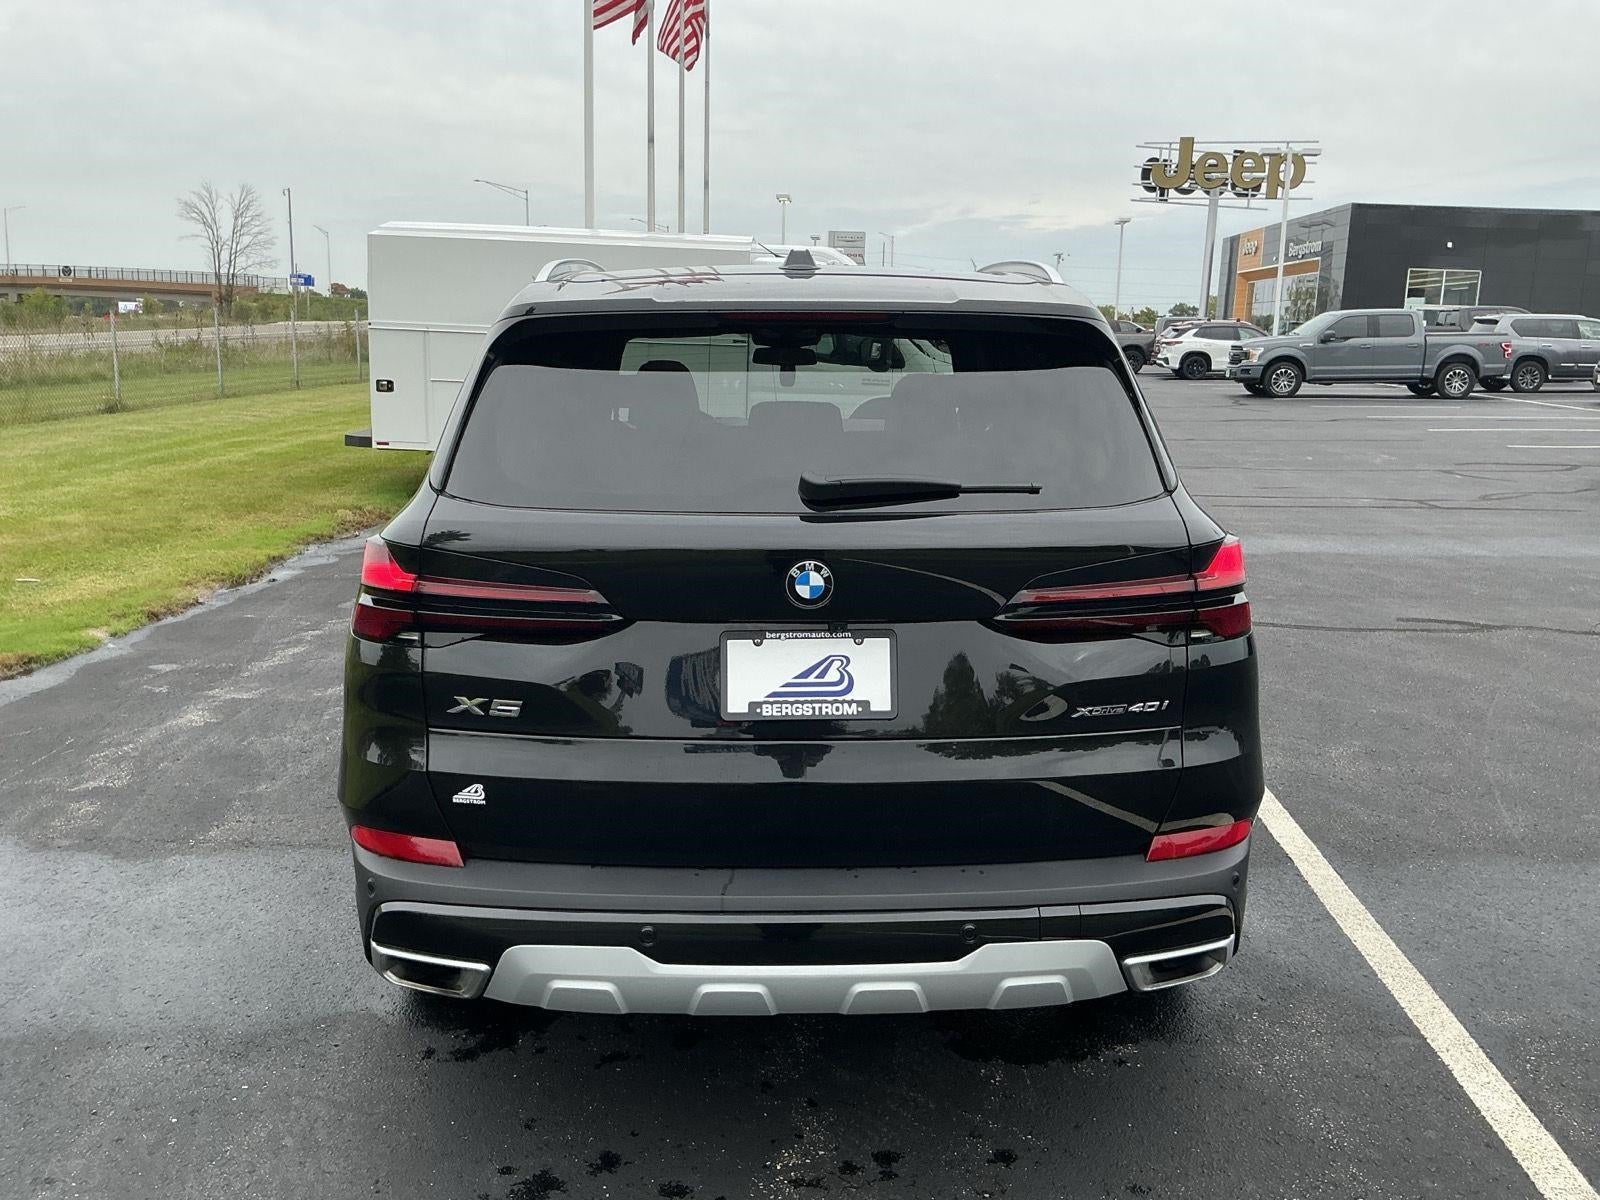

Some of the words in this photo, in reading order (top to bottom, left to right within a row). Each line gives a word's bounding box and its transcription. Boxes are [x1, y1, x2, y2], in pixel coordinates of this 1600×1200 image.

[1151, 137, 1306, 199] Jeep
[1288, 241, 1322, 259] Bergstrom
[790, 562, 830, 578] BMW
[765, 631, 852, 641] bergstromauto.com
[446, 696, 523, 718] X5
[761, 703, 858, 717] BERGSTROM
